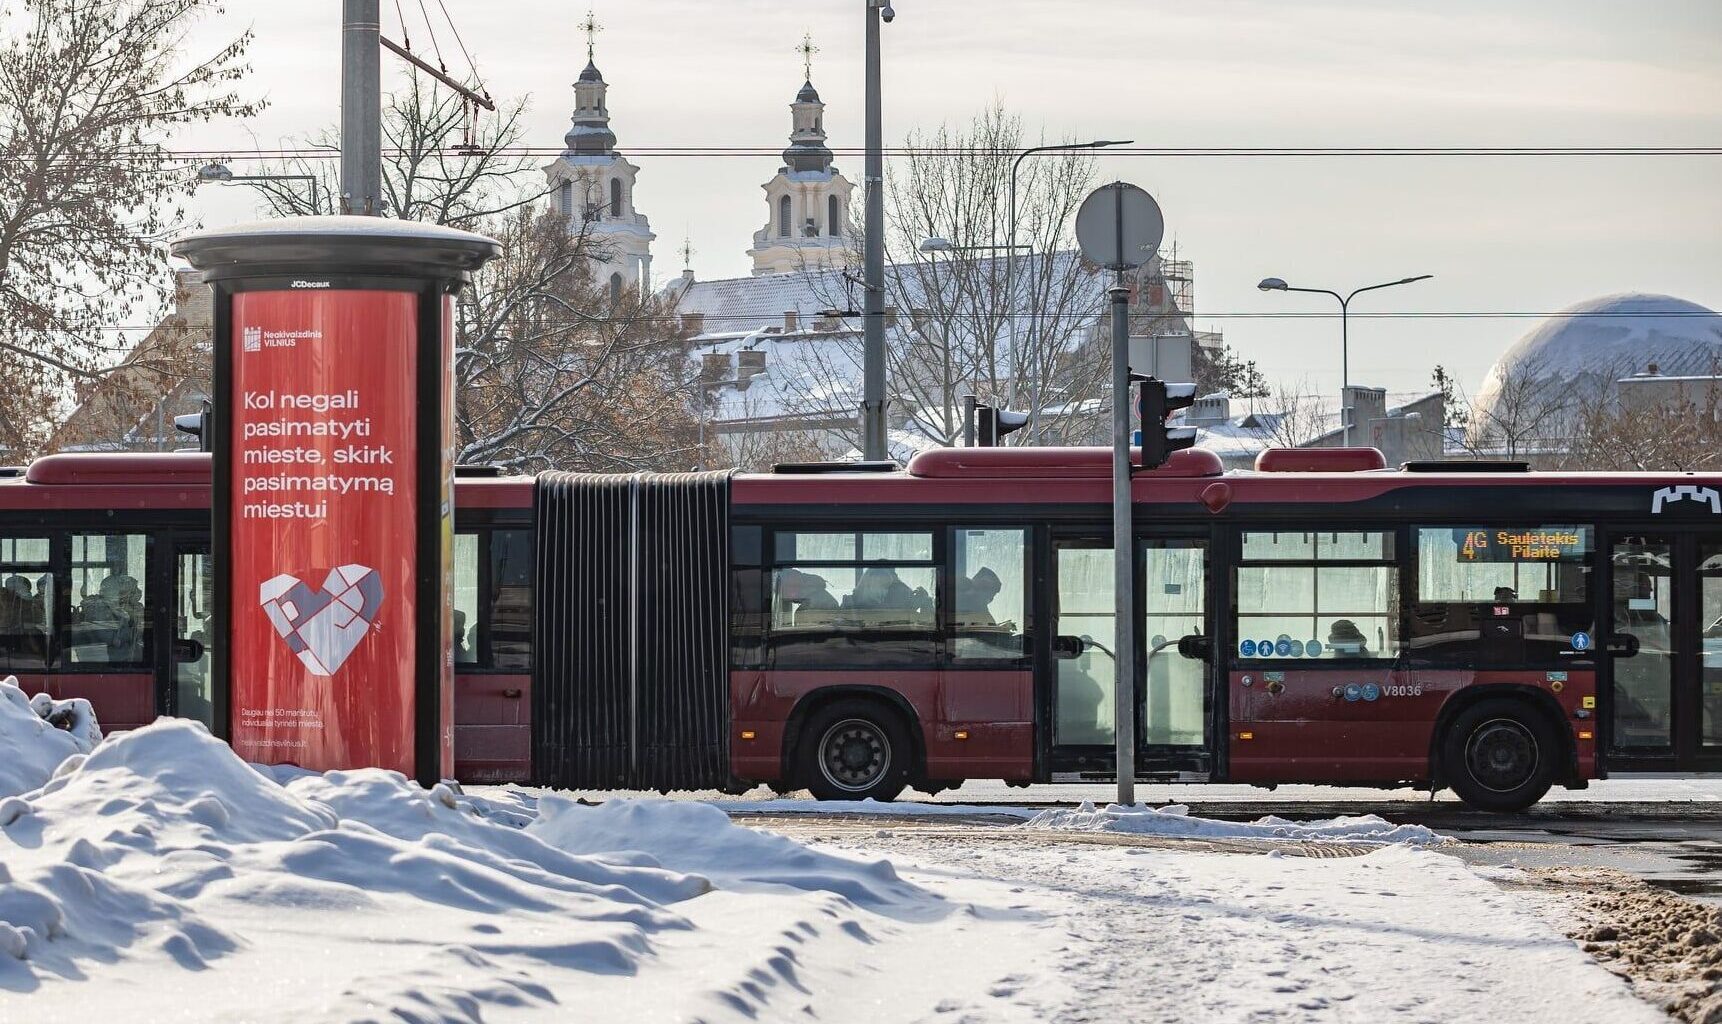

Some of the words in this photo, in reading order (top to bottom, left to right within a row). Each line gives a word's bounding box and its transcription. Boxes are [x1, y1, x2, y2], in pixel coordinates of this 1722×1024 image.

[291, 280, 330, 288] JCDecaux
[263, 329, 322, 339] Neakivaizdinis
[264, 339, 296, 347] VILNIUS
[244, 391, 275, 409] Kol
[280, 390, 359, 412] negali
[244, 418, 370, 440] pasimatyti
[244, 446, 327, 465] mieste,
[333, 445, 393, 464] skirk
[244, 473, 394, 495] pasimatymą
[244, 500, 328, 518] miestui
[1382, 685, 1422, 697] V8036
[275, 708, 285, 716] 50
